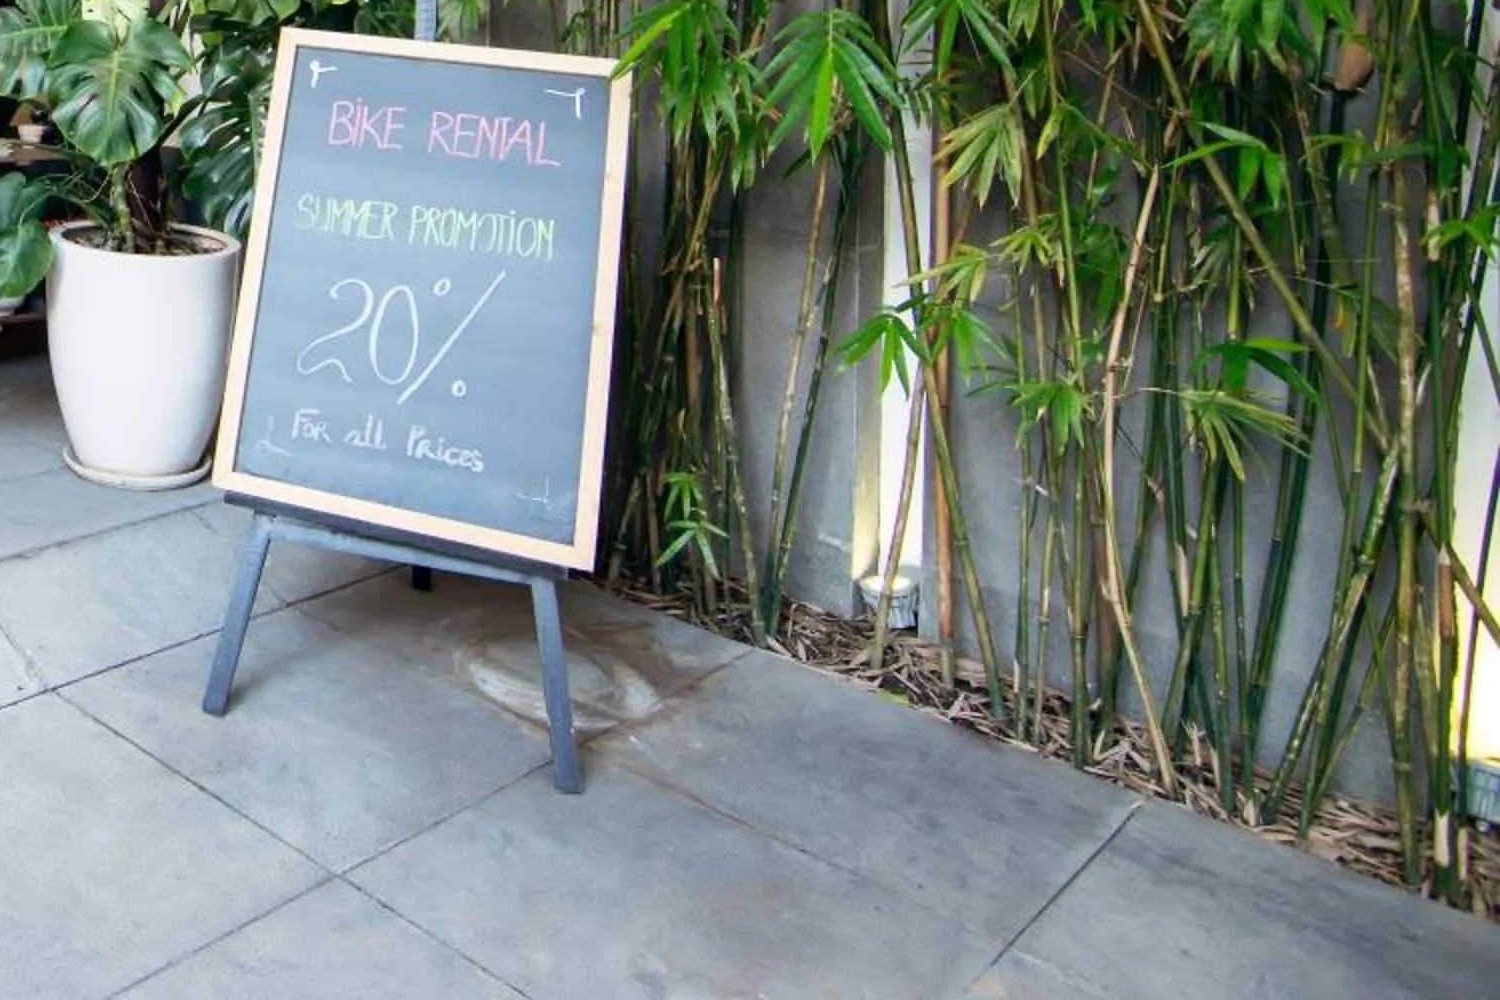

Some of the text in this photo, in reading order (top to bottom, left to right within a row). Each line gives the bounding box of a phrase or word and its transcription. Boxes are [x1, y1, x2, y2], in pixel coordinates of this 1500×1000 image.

[427, 110, 562, 168] RENTAL
[296, 192, 400, 242] SUMMER
[296, 270, 507, 405] 20%
[342, 413, 388, 450] all
